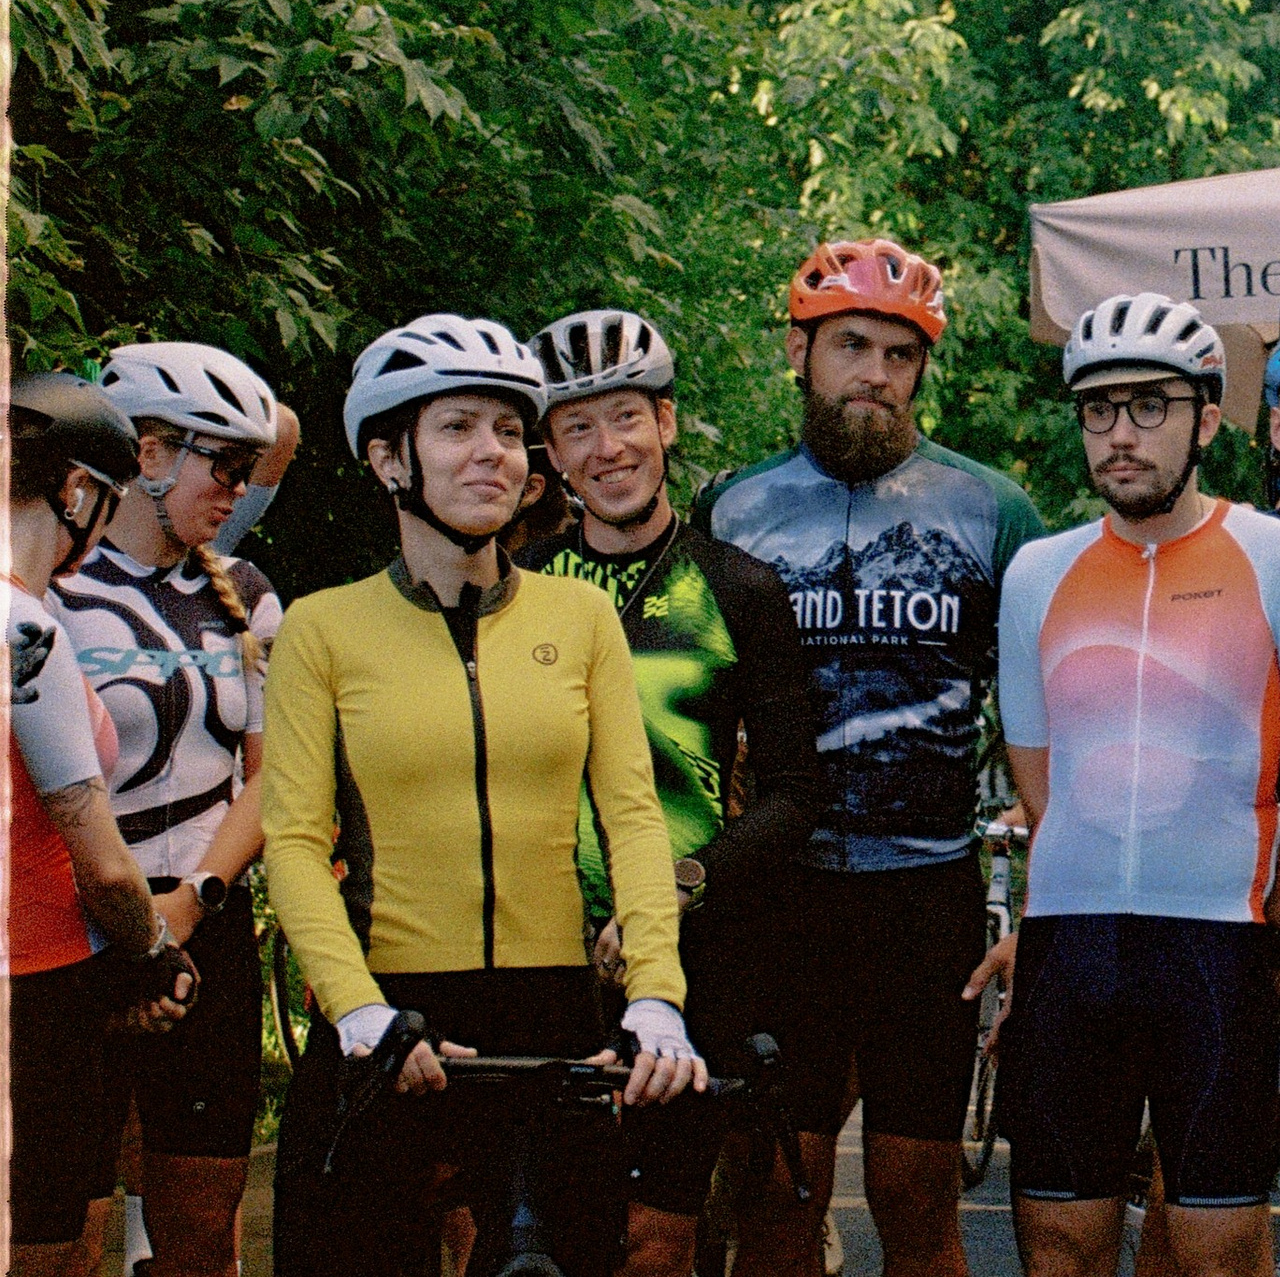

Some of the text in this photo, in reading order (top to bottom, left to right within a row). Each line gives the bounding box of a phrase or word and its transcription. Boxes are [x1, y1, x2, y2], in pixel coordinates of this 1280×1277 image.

[789, 589, 960, 634] AND TETON
[872, 634, 909, 646] PARK
